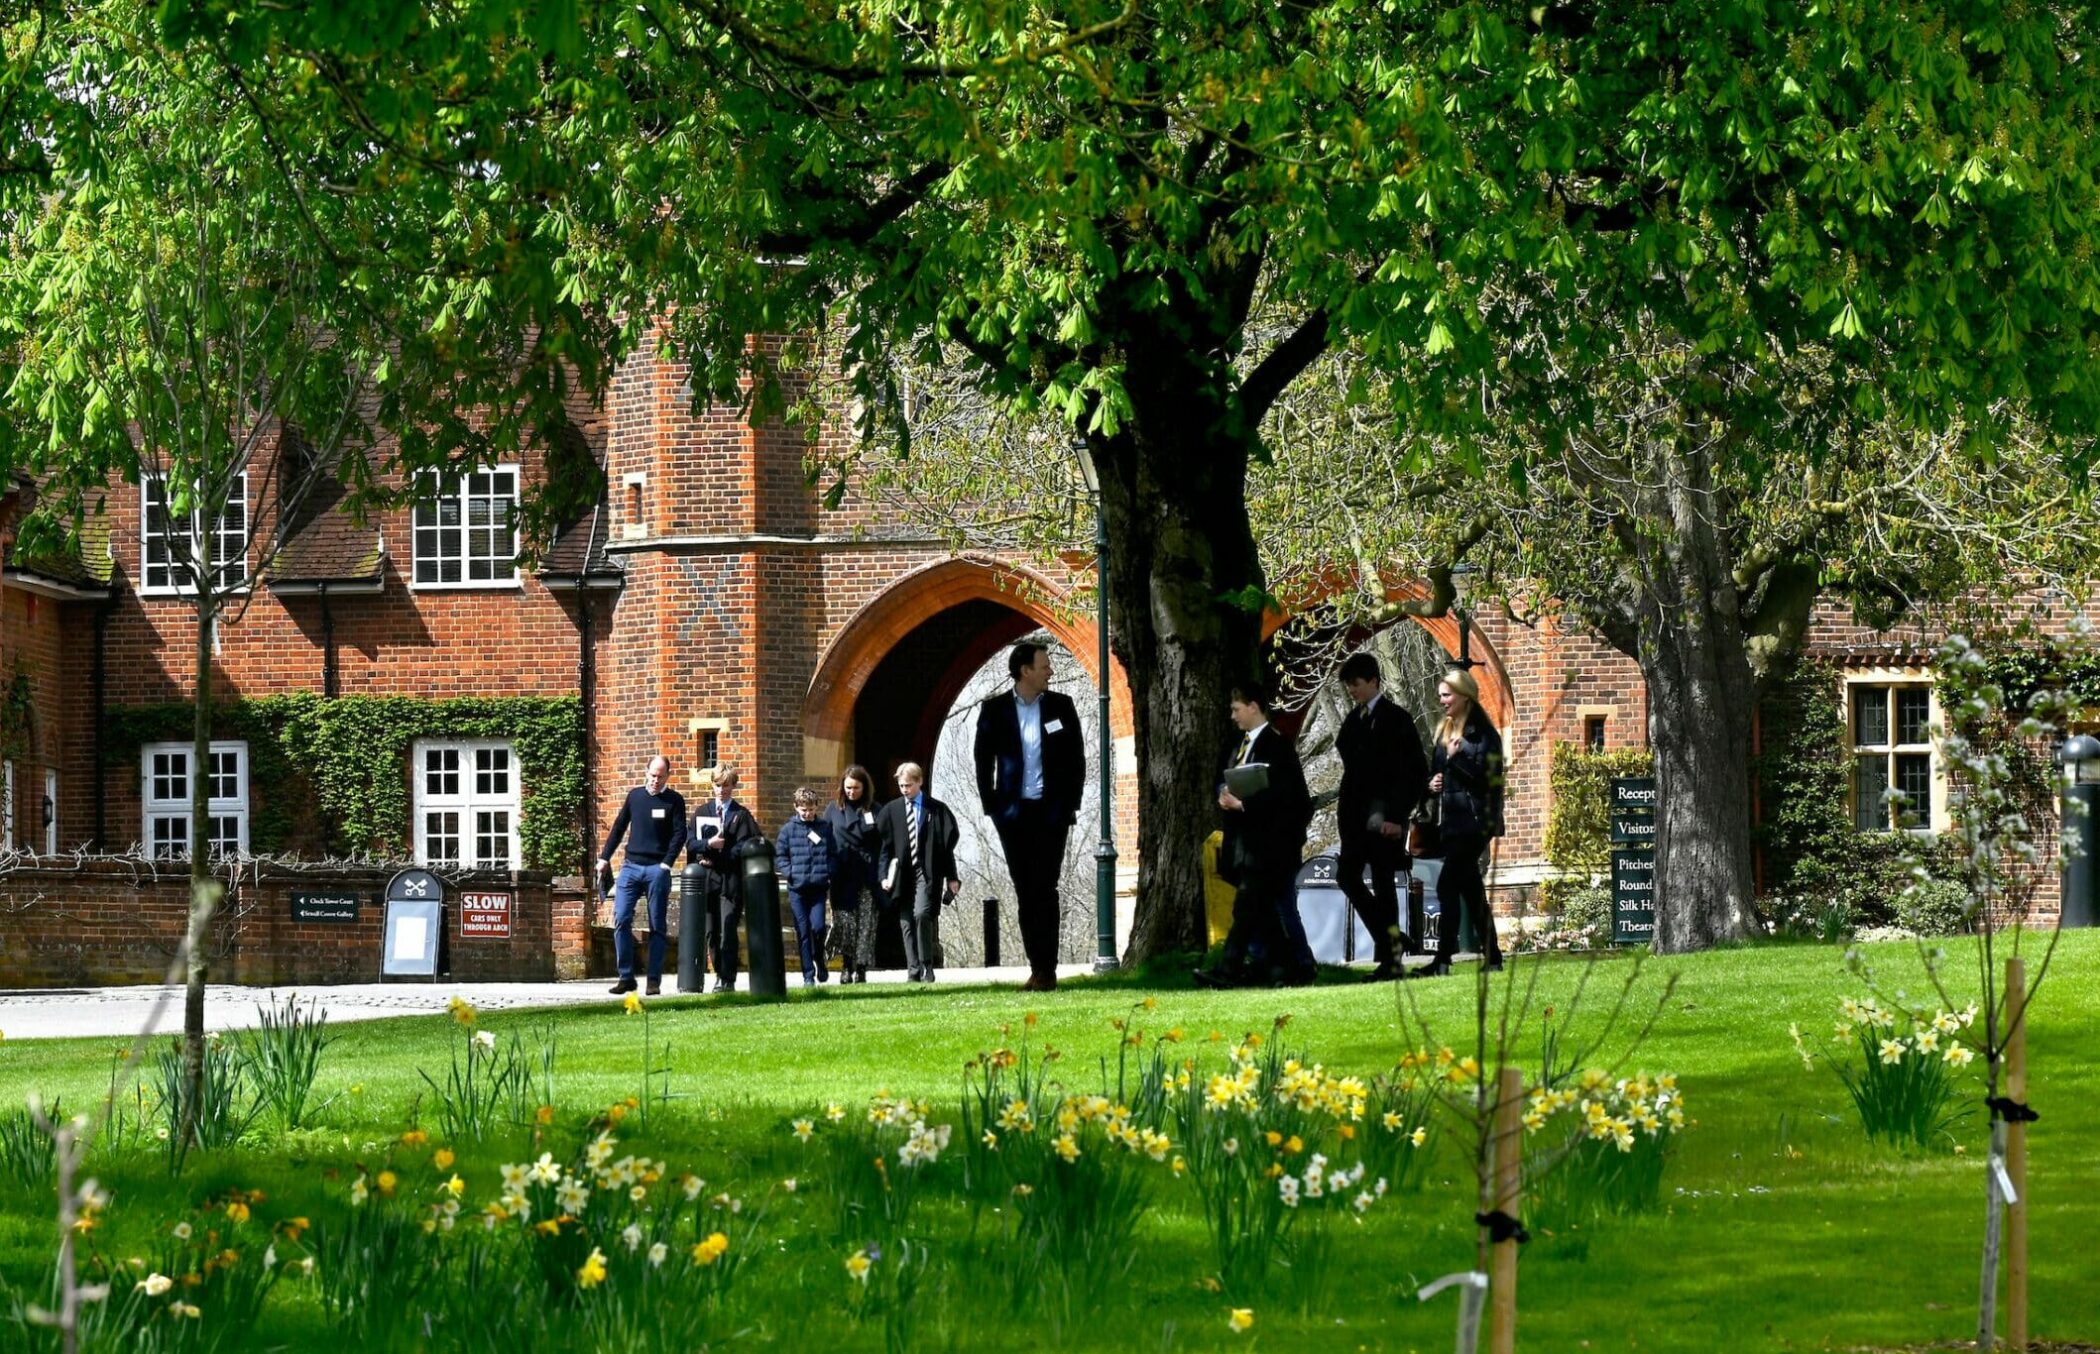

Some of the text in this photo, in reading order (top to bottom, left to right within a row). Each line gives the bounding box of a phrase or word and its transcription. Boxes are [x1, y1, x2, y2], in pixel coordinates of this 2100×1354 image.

[1618, 822, 1655, 835] Visitor
[1619, 879, 1653, 891] Round
[463, 895, 508, 910] SLOW
[1619, 899, 1638, 911] Silk
[470, 914, 502, 923] CARS ONLY
[463, 923, 508, 931] THROUGH ARCH
